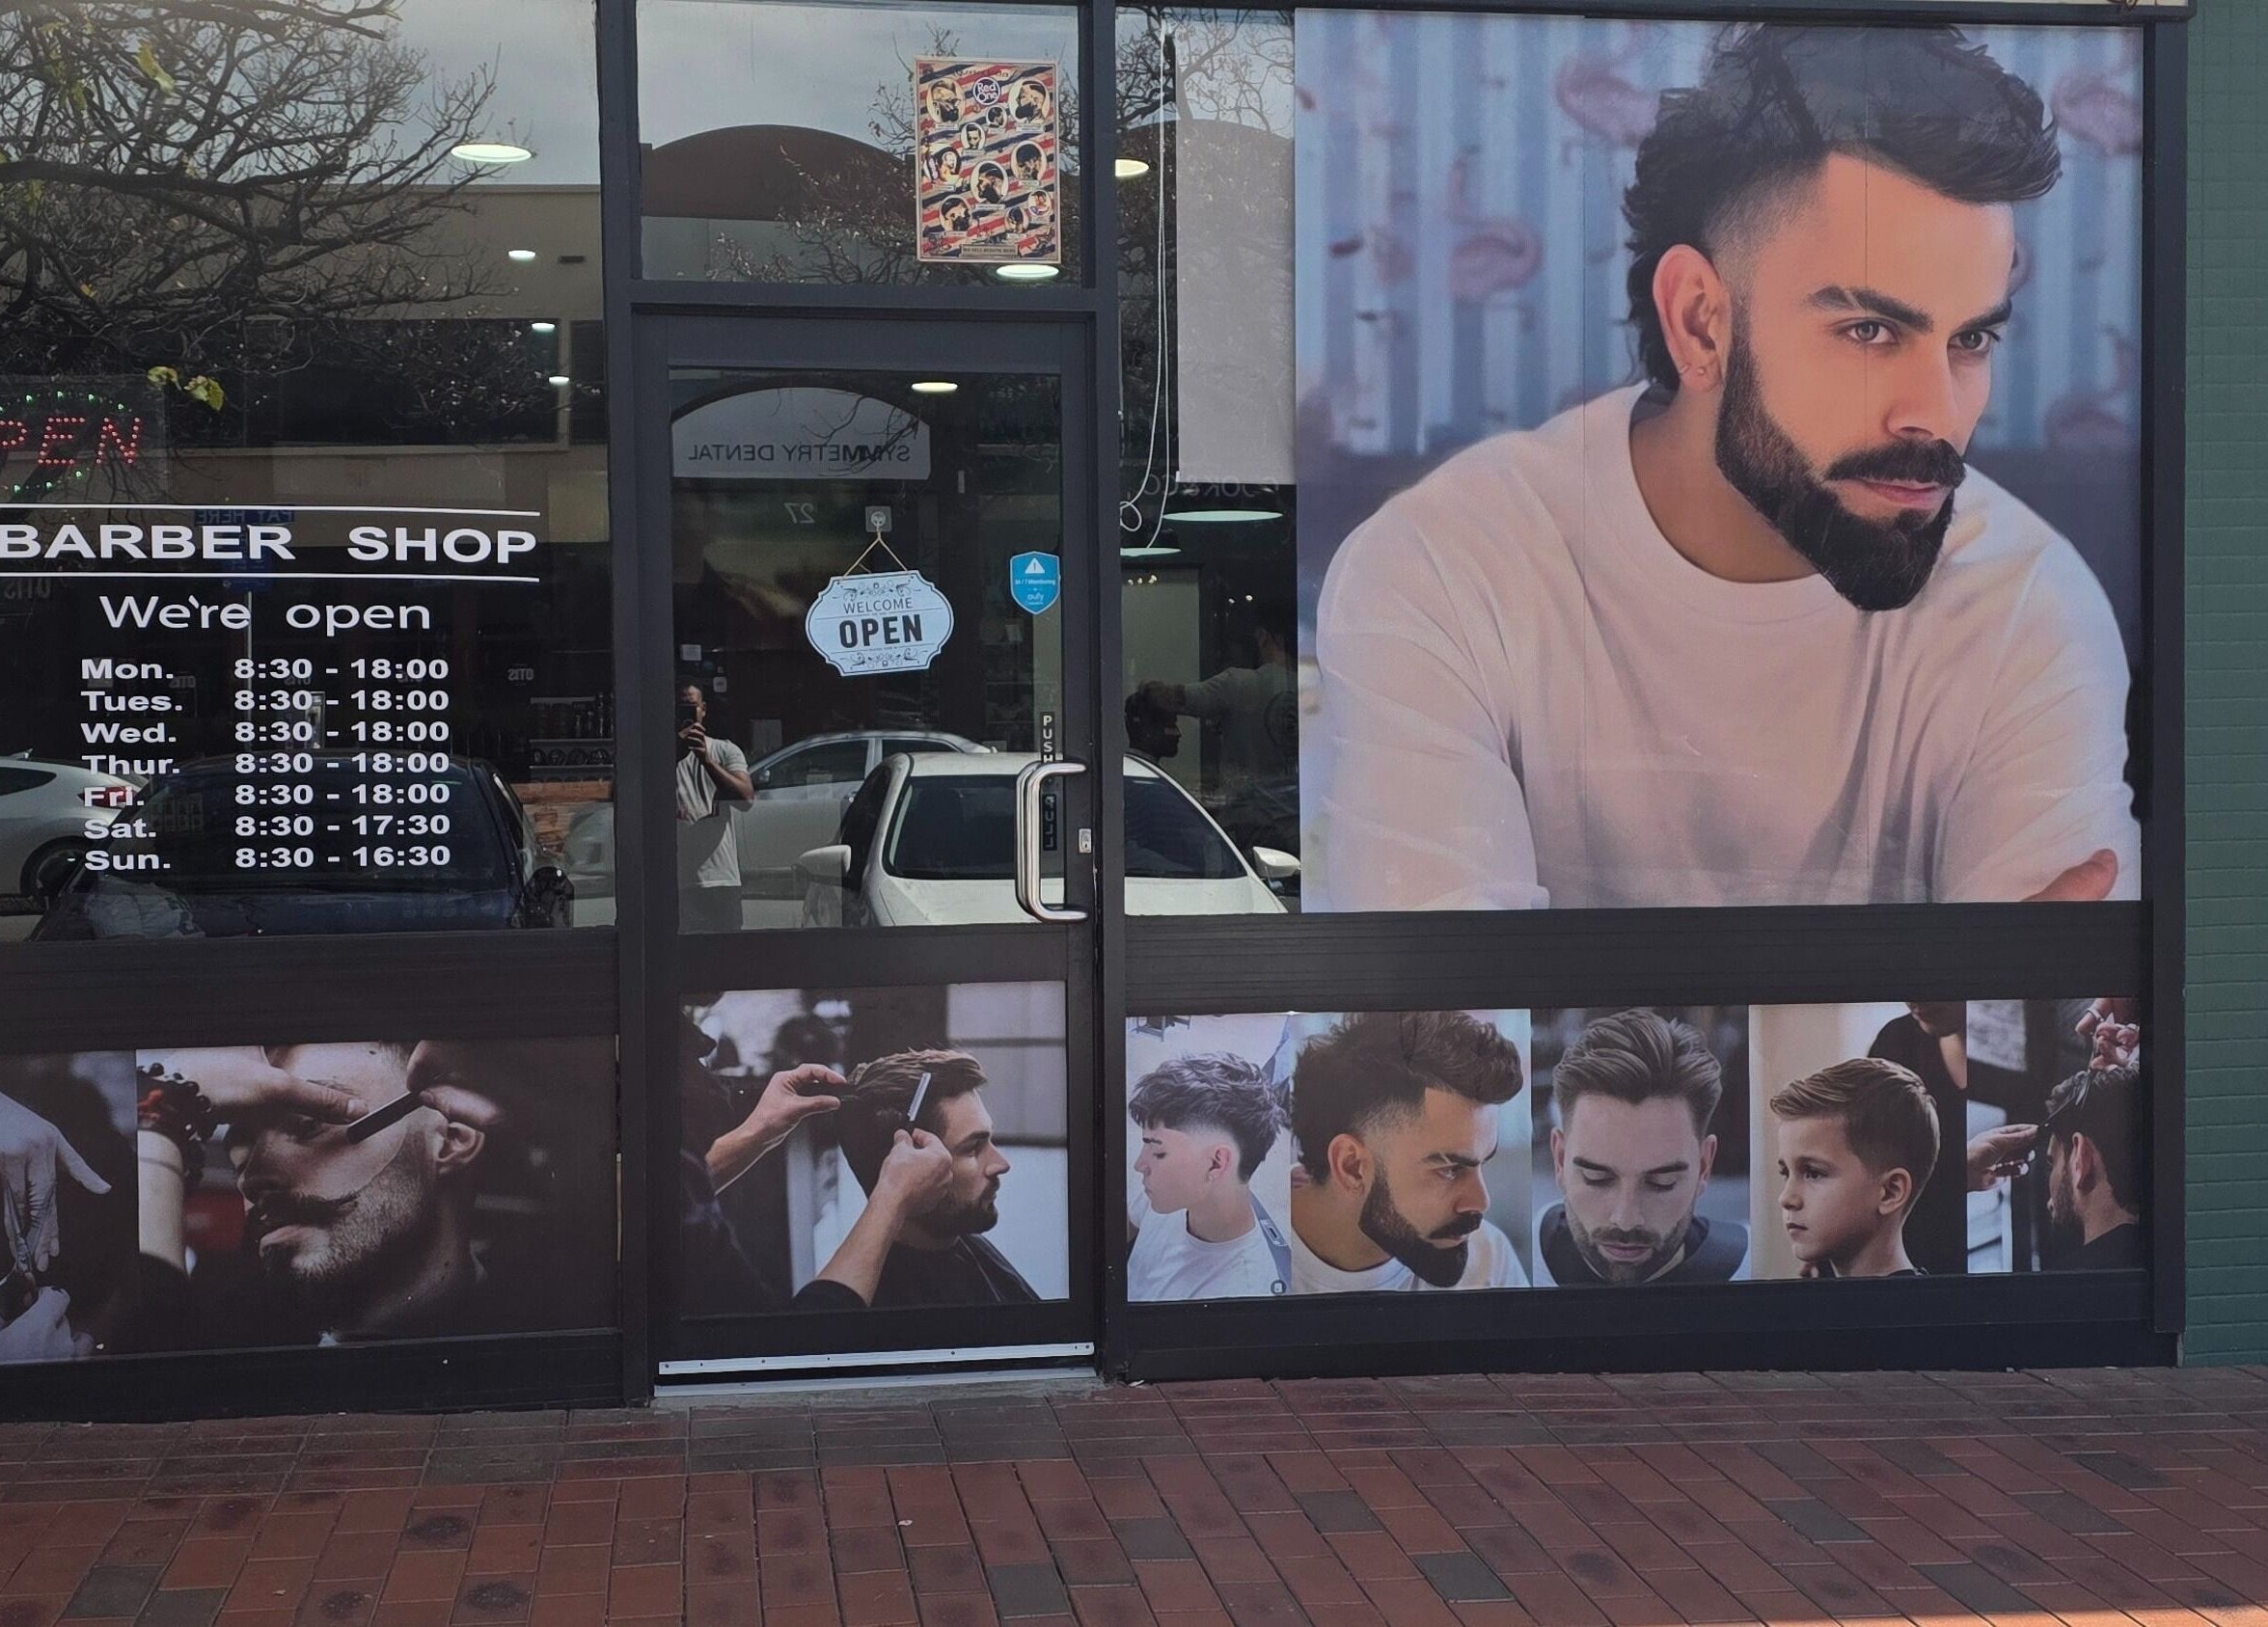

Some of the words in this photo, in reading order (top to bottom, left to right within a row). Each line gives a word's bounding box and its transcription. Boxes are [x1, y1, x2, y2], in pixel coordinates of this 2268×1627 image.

[976, 82, 997, 94] Red
[977, 91, 998, 102] One
[0, 524, 296, 560] BARBER
[347, 526, 536, 564] SHOP
[843, 597, 915, 614] WELCOME
[286, 604, 430, 637] open
[839, 614, 923, 649] OPEN
[81, 659, 174, 680] Mon.
[234, 658, 313, 679] 8:30
[350, 658, 449, 679] 18:00
[81, 691, 183, 712] Tues.
[234, 690, 313, 711] 8:30
[350, 690, 450, 711] 18:00
[81, 722, 177, 744] Wed.
[234, 720, 313, 742] 8:30
[350, 720, 450, 742] 18:00
[1043, 715, 1053, 764] PUSH
[82, 754, 180, 774] Thur.
[234, 752, 314, 773] 8:30
[351, 752, 450, 773] 18:00
[83, 786, 146, 807] Fri.
[234, 784, 314, 805] 8:30
[351, 783, 451, 804] 18:00
[83, 817, 156, 839] Sat.
[234, 816, 314, 836] 8:30
[351, 814, 451, 835] 17:30
[84, 850, 171, 871] Sun.
[235, 847, 314, 868] 8:30
[352, 845, 451, 867] 16:30
